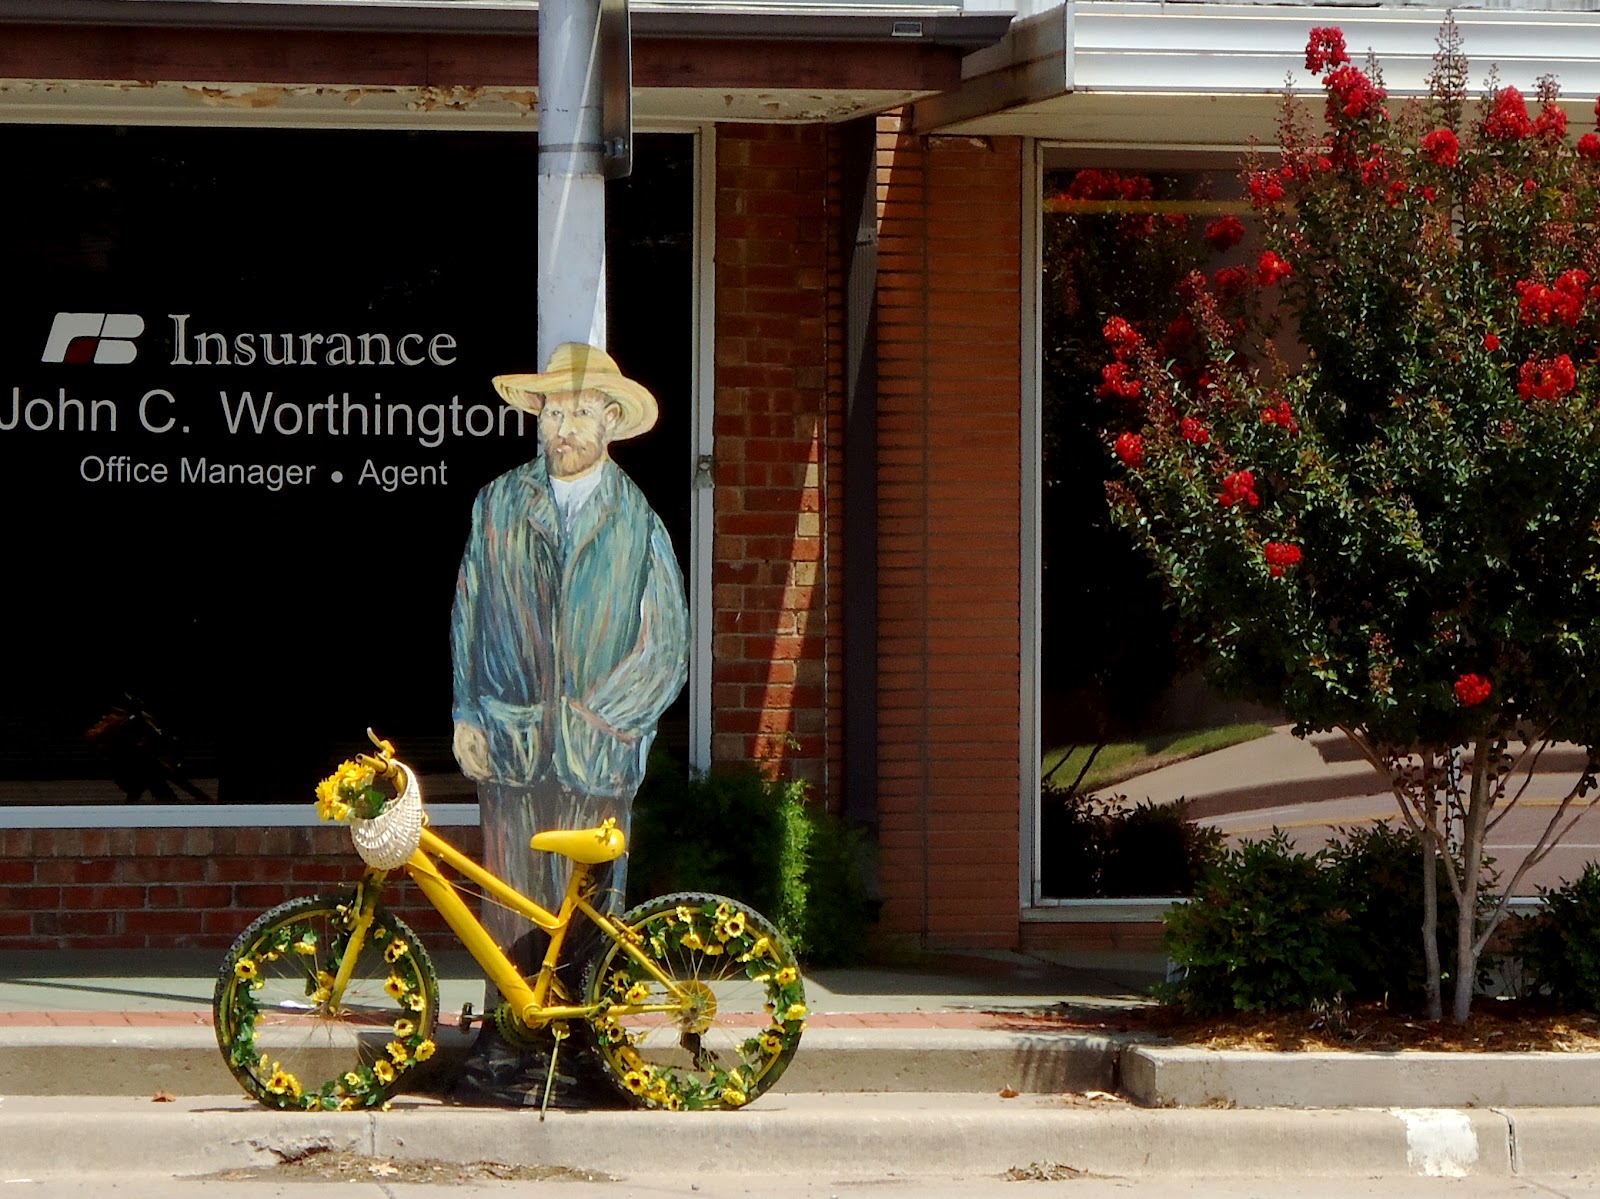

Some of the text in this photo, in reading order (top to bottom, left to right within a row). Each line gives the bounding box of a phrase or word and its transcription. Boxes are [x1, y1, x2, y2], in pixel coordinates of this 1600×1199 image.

[167, 313, 458, 366] Insurance
[0, 387, 525, 448] John C. Worthington
[80, 455, 448, 493] Office Manager Agent
